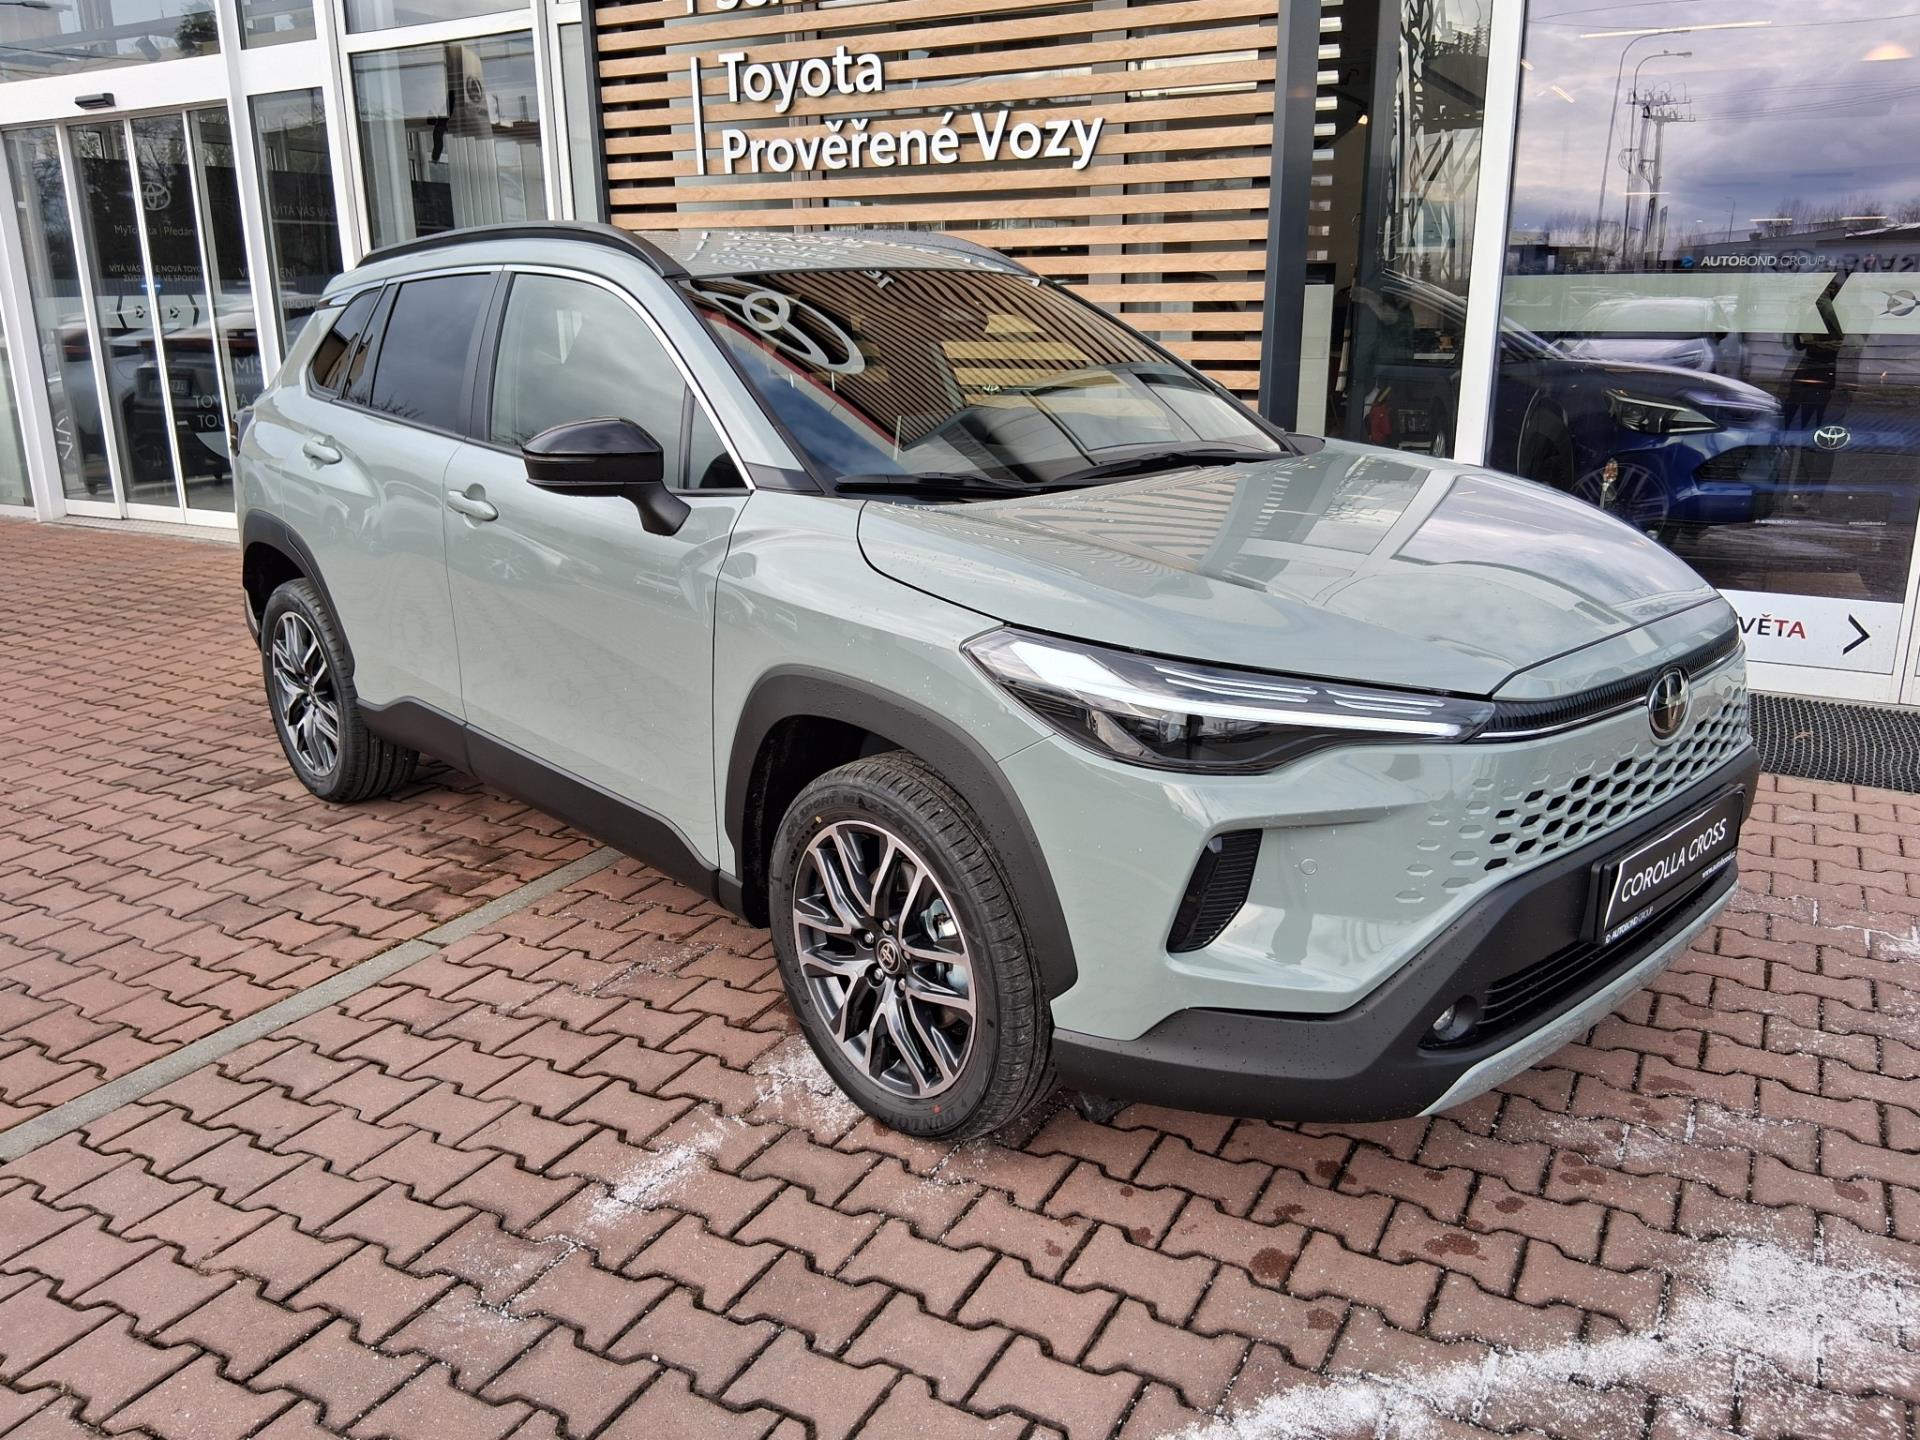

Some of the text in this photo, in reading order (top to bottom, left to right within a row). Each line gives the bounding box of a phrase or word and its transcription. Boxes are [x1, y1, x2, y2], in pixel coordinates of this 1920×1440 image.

[718, 45, 884, 113] Toyota
[722, 108, 1105, 175] Prověřené Vozy
[114, 224, 157, 237] MyTota
[1700, 255, 1778, 266] AUTOBOND
[1779, 255, 1826, 267] GROUP
[1621, 817, 1727, 903] COROLLA CROSS
